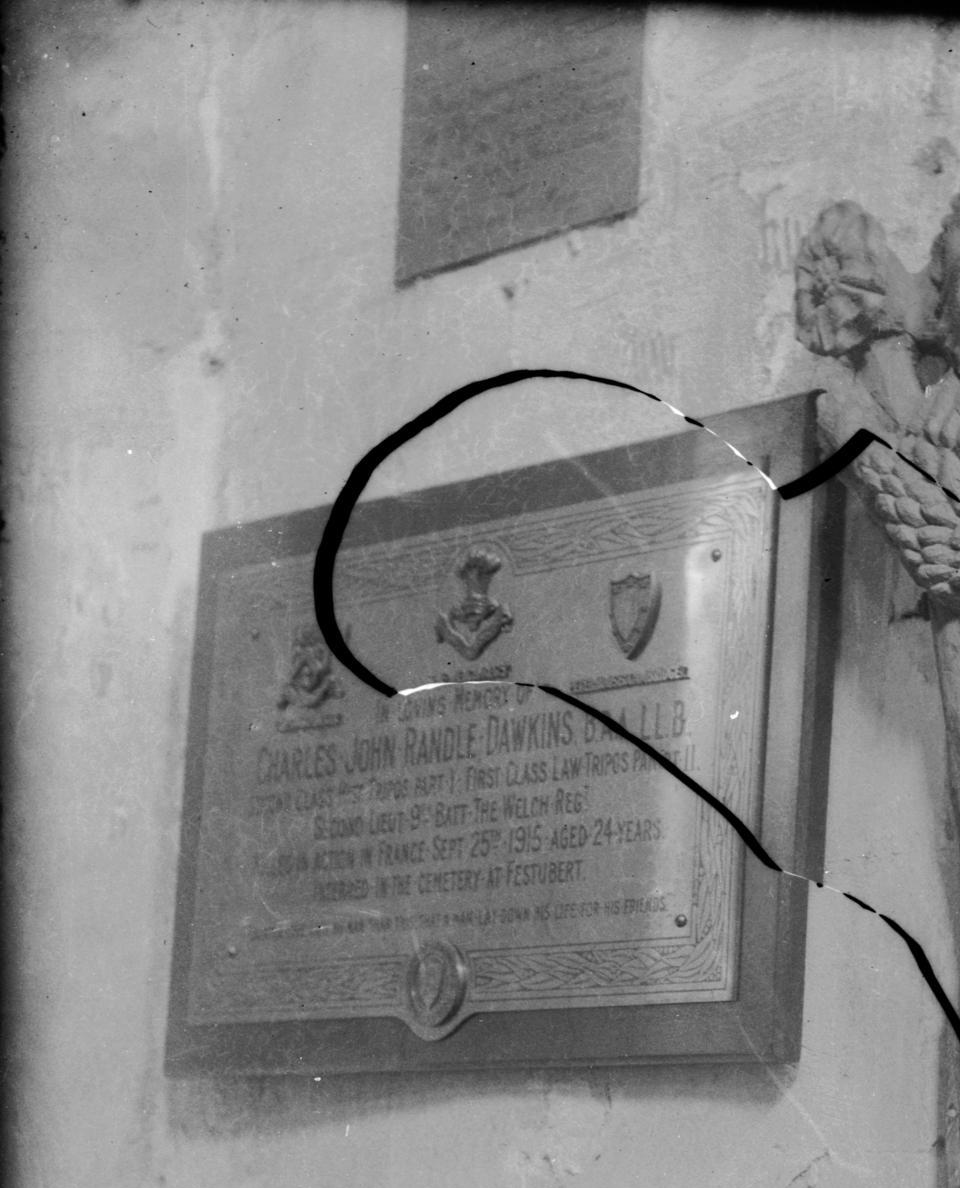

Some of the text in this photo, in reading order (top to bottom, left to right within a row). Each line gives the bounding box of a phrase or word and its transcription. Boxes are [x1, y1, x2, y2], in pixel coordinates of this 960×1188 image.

[256, 743, 336, 784] CHARLES
[344, 736, 396, 773] JOHN
[405, 723, 477, 765] RANDLE
[466, 765, 501, 792] FIRST
[507, 761, 548, 787] CLASS
[552, 756, 582, 781] LAW
[473, 797, 498, 823] THE
[503, 793, 550, 820] WELCH
[508, 824, 542, 854] 1915
[551, 824, 588, 849] AGED
[592, 816, 613, 846] 24
[418, 869, 481, 894] CEMETERY
